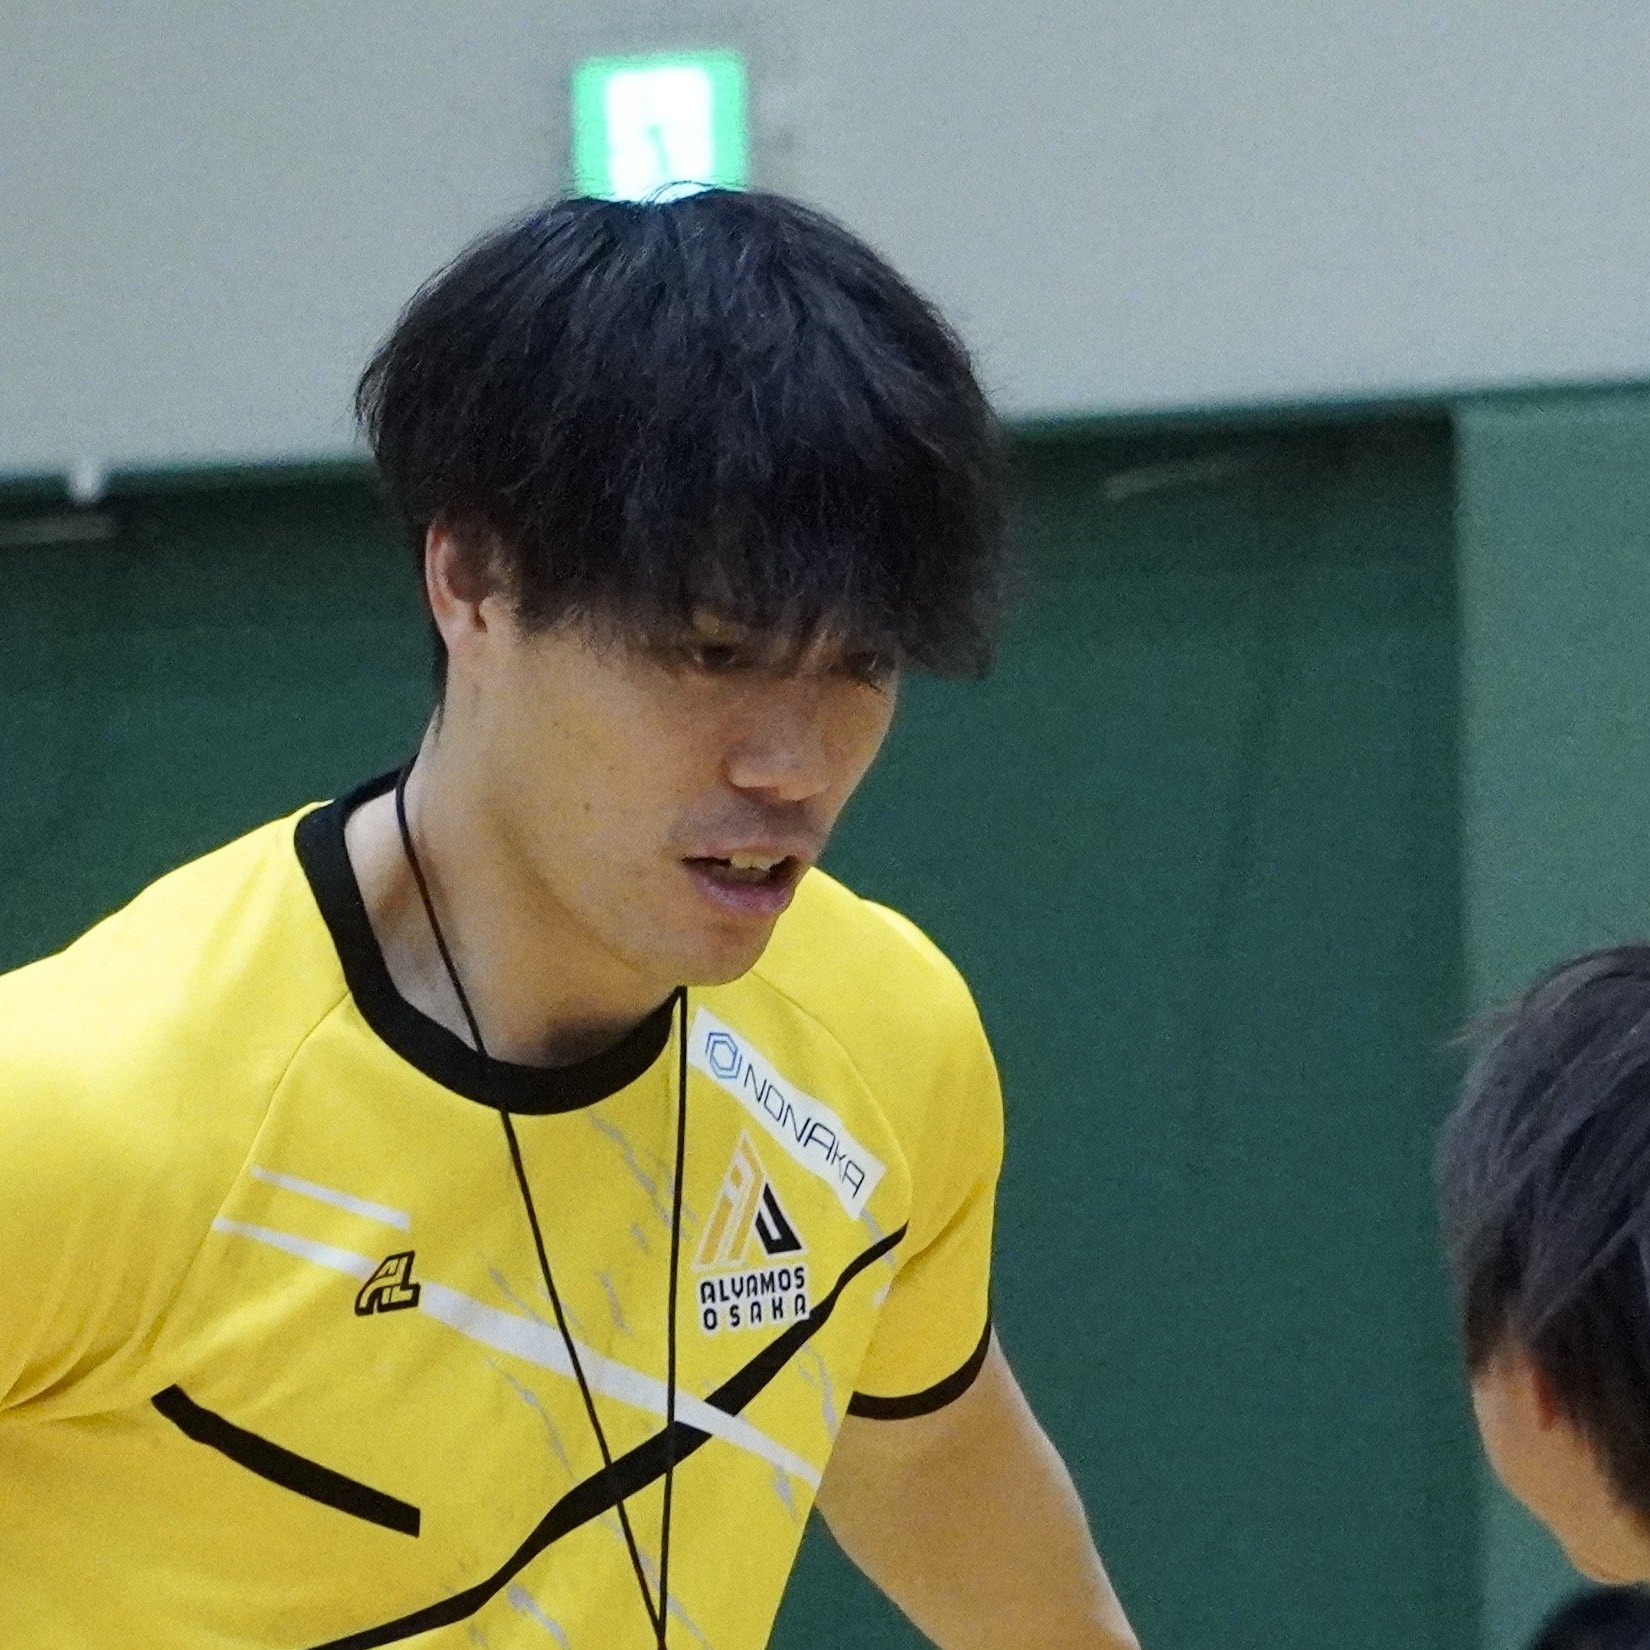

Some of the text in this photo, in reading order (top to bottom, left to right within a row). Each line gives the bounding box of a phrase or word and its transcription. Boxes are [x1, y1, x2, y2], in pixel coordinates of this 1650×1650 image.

[743, 1063, 866, 1199] NONAKA
[699, 1266, 805, 1304] ALVAMOS
[703, 1294, 807, 1331] OSAKA
